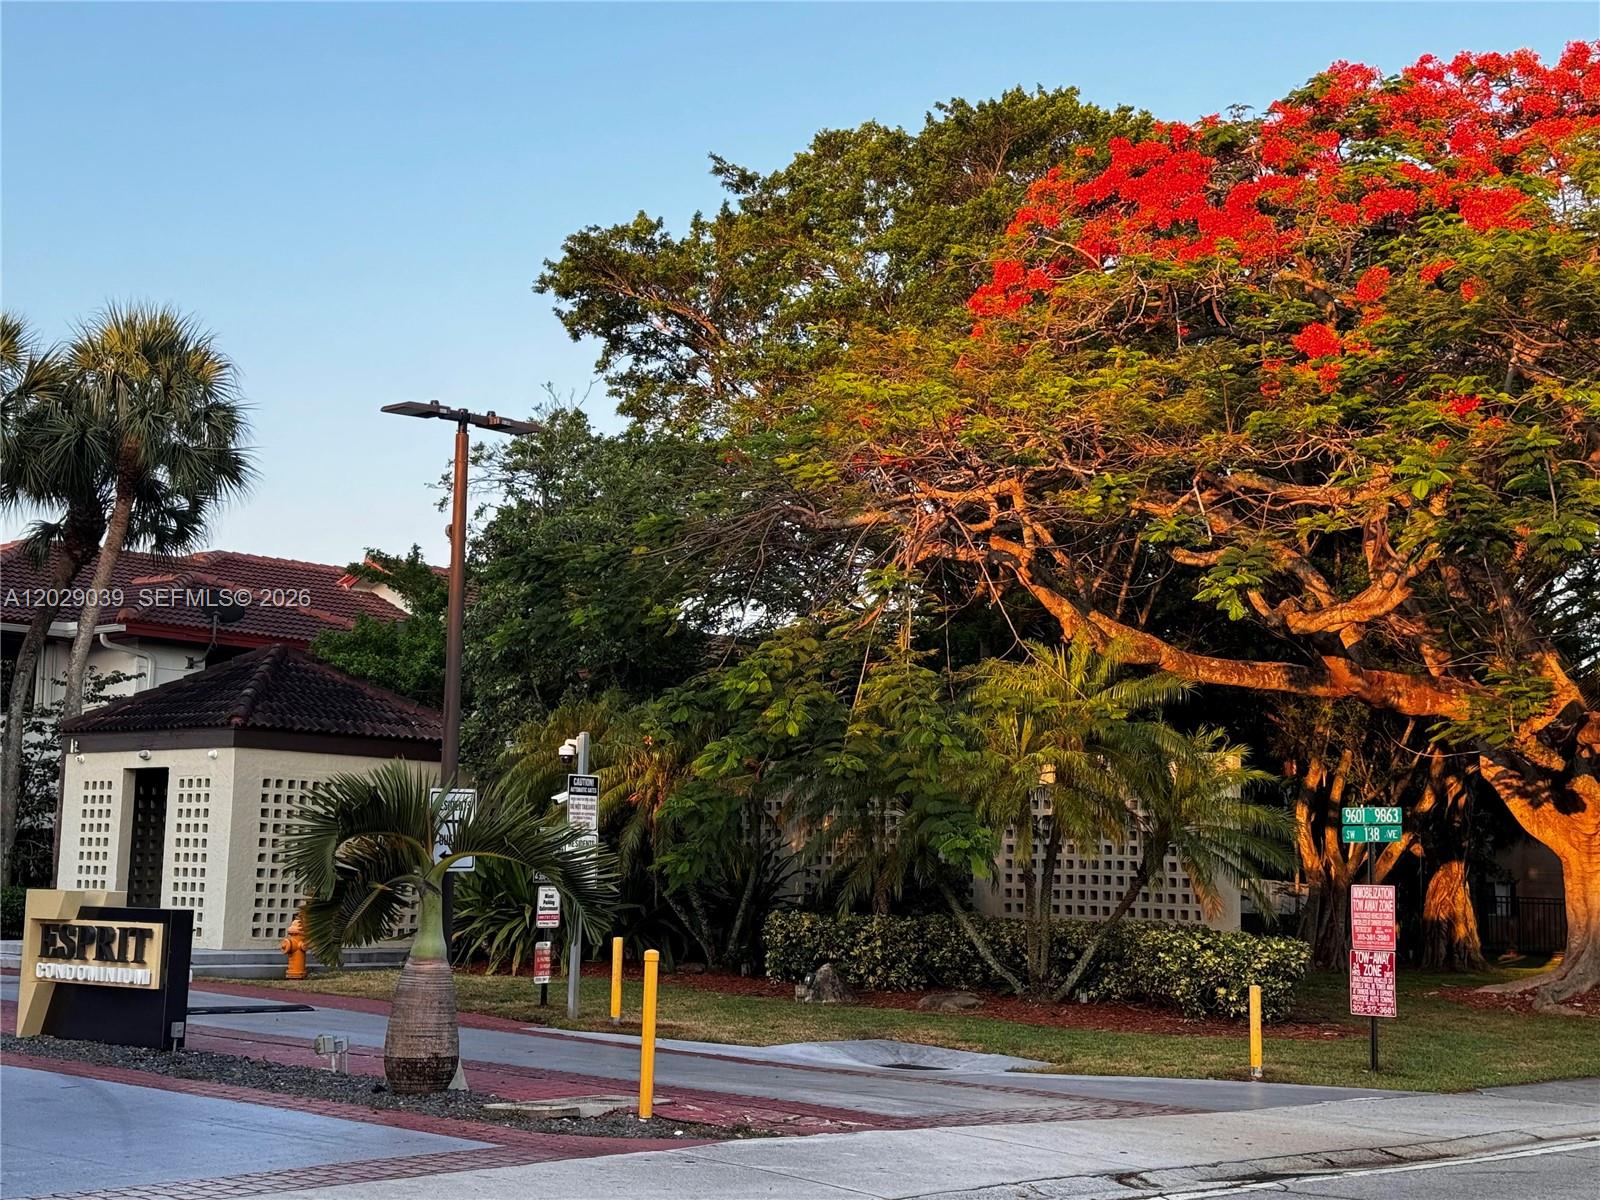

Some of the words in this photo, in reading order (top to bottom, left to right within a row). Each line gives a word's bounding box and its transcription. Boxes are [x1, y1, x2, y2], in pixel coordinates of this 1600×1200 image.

[1345, 808, 1366, 823] 9601
[1374, 808, 1399, 823] 9863
[1346, 830, 1356, 839] SW
[1364, 827, 1380, 841] 138
[1353, 899, 1364, 912] TOW
[1364, 899, 1379, 912] AWAY
[1379, 900, 1394, 912] ZONE
[38, 923, 154, 964] ESPRIT
[1355, 951, 1390, 965] TOW-AWAY
[36, 962, 152, 985] CONDOMINIUM
[1363, 964, 1382, 977] ZONE
